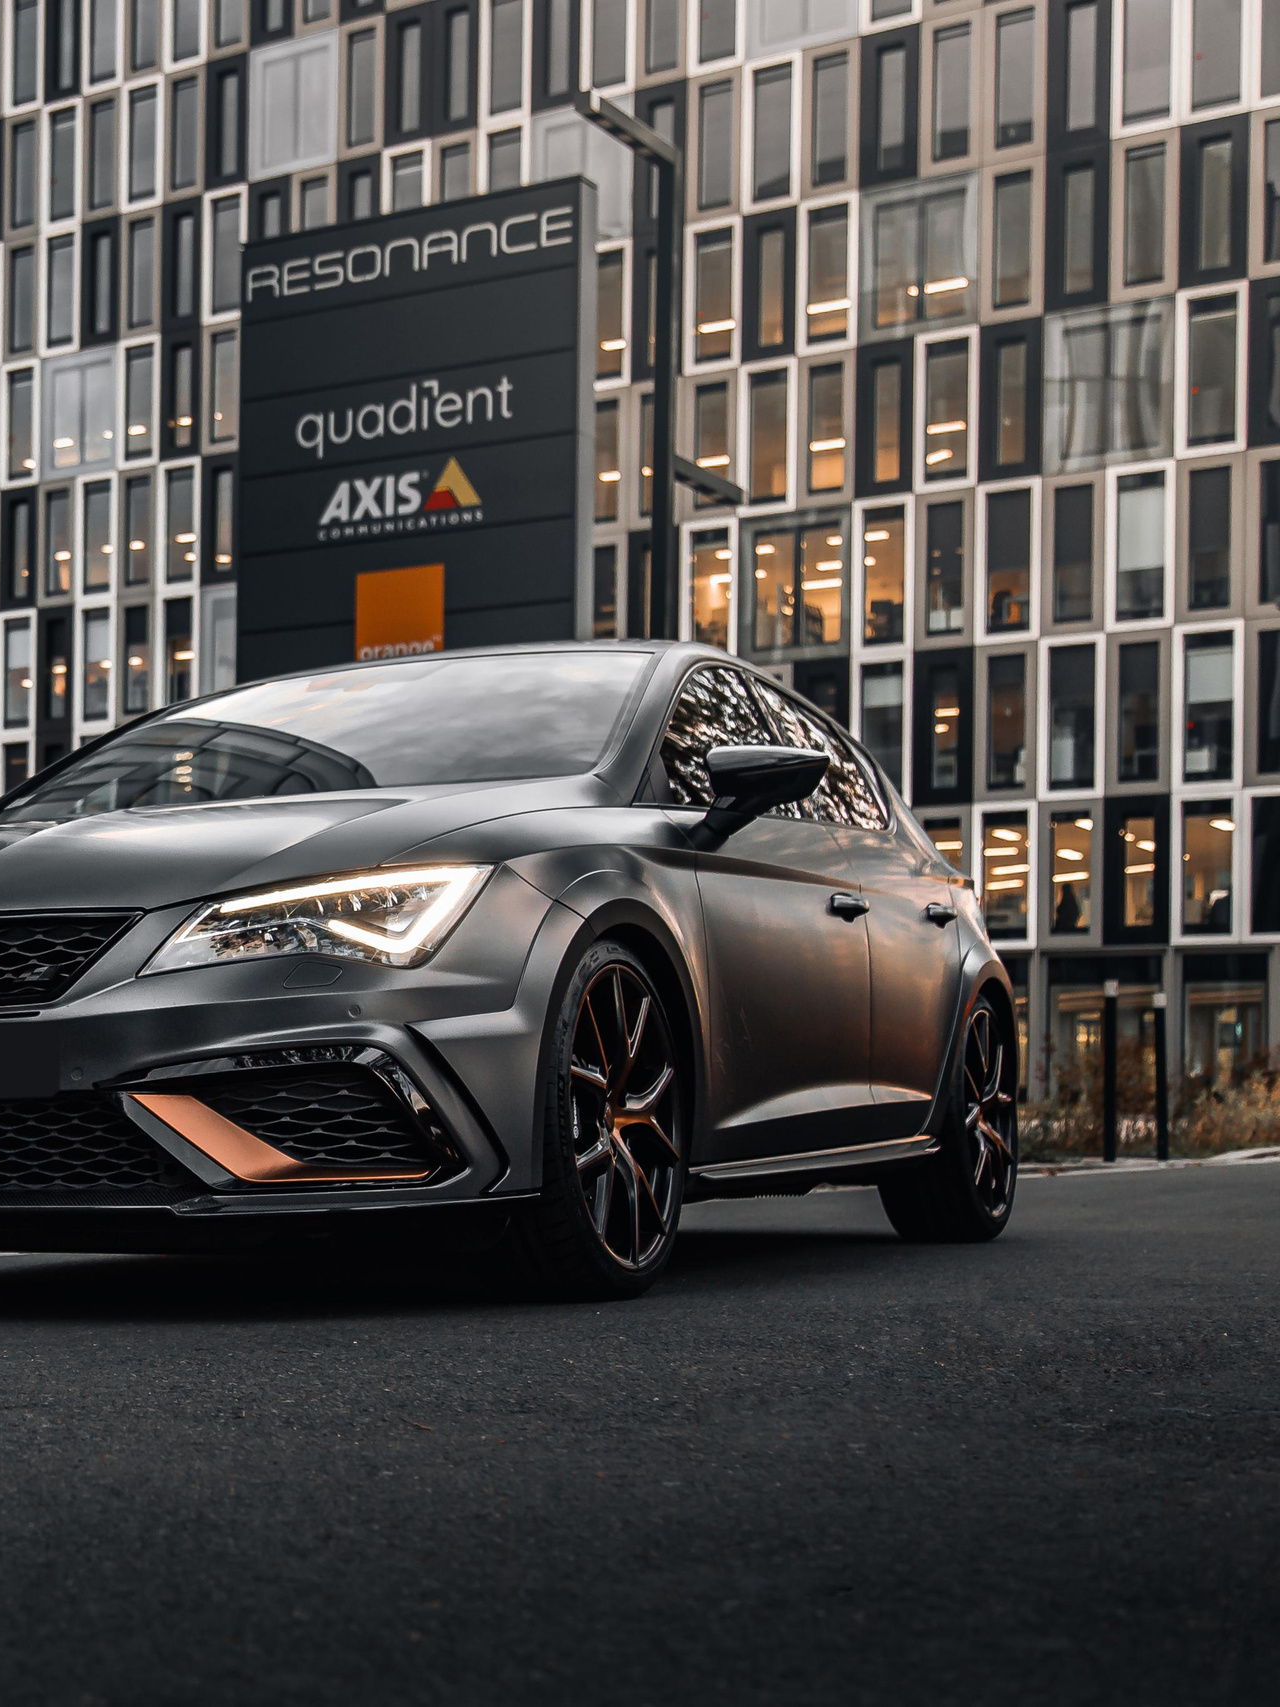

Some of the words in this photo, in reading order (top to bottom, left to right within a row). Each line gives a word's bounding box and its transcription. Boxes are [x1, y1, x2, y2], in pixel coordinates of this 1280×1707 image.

[246, 205, 573, 303] RESONANCE
[295, 374, 514, 460] quadient
[317, 508, 484, 542] COMMUNICATIONS
[319, 470, 422, 526] AXIS
